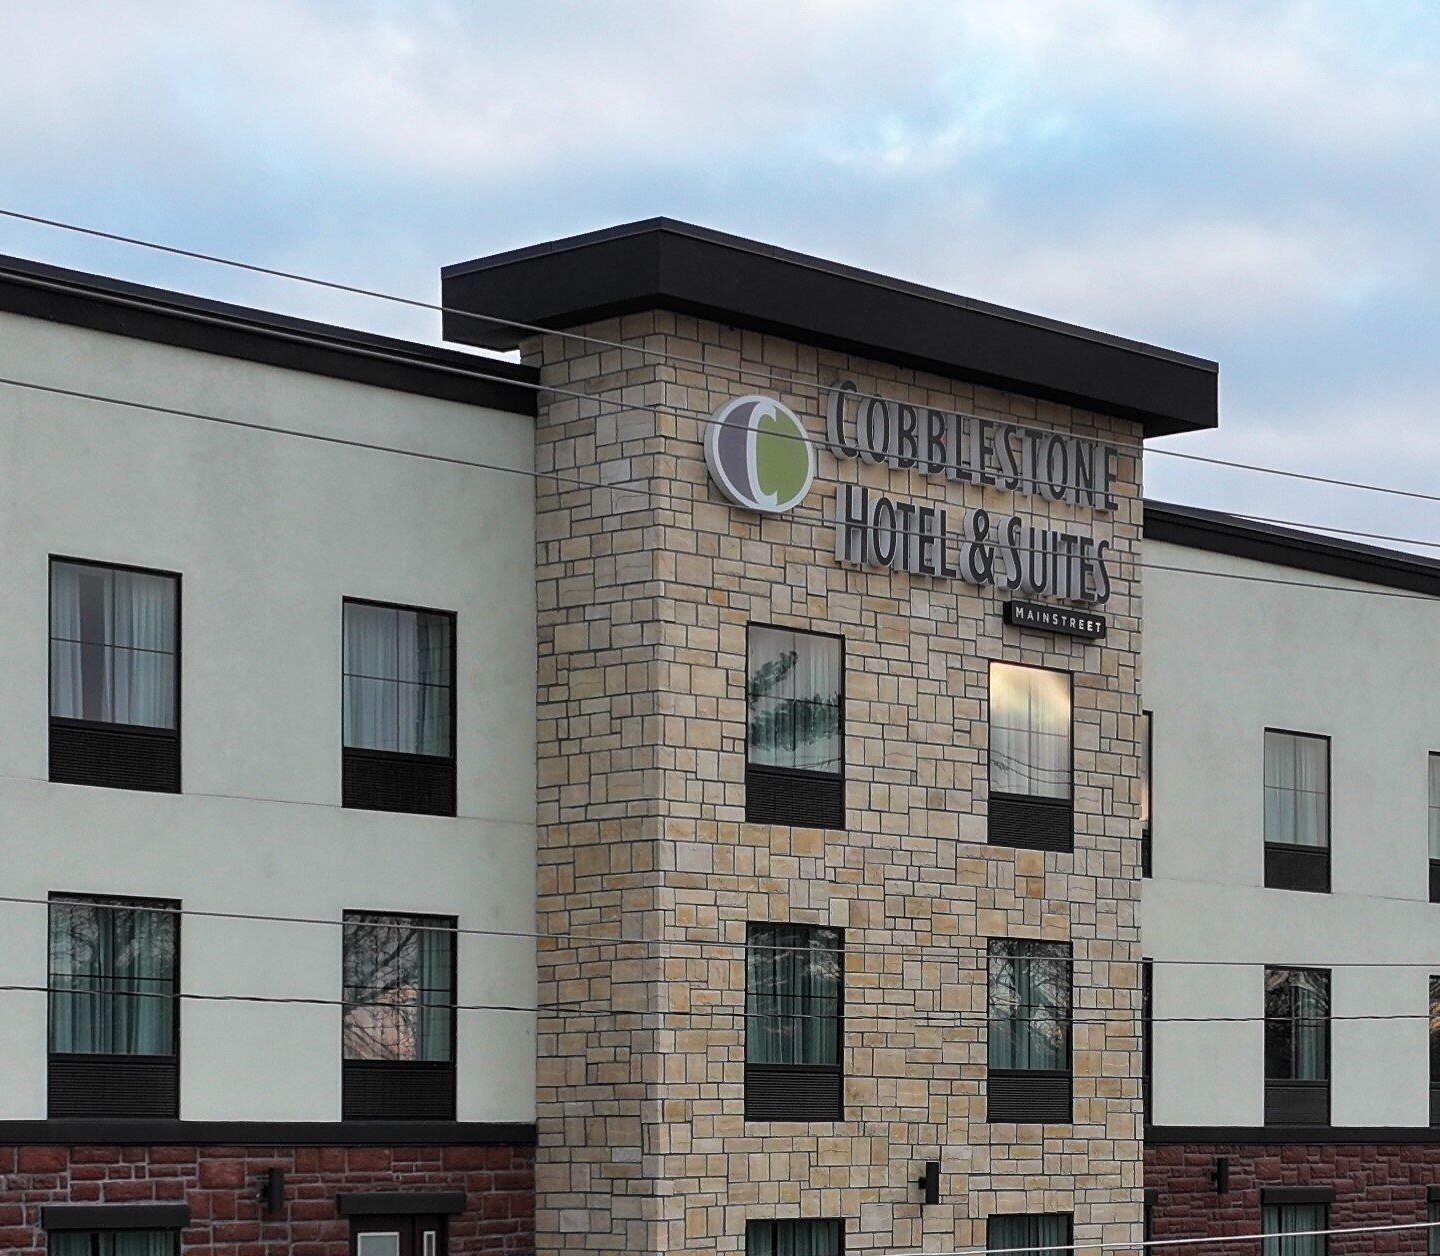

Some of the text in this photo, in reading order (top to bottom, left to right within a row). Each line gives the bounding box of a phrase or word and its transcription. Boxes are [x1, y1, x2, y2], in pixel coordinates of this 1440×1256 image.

[828, 380, 1119, 512] COBBLESTONE
[835, 484, 1112, 605] HOTEL & SUITES
[1015, 605, 1104, 635] MAINSTREET
